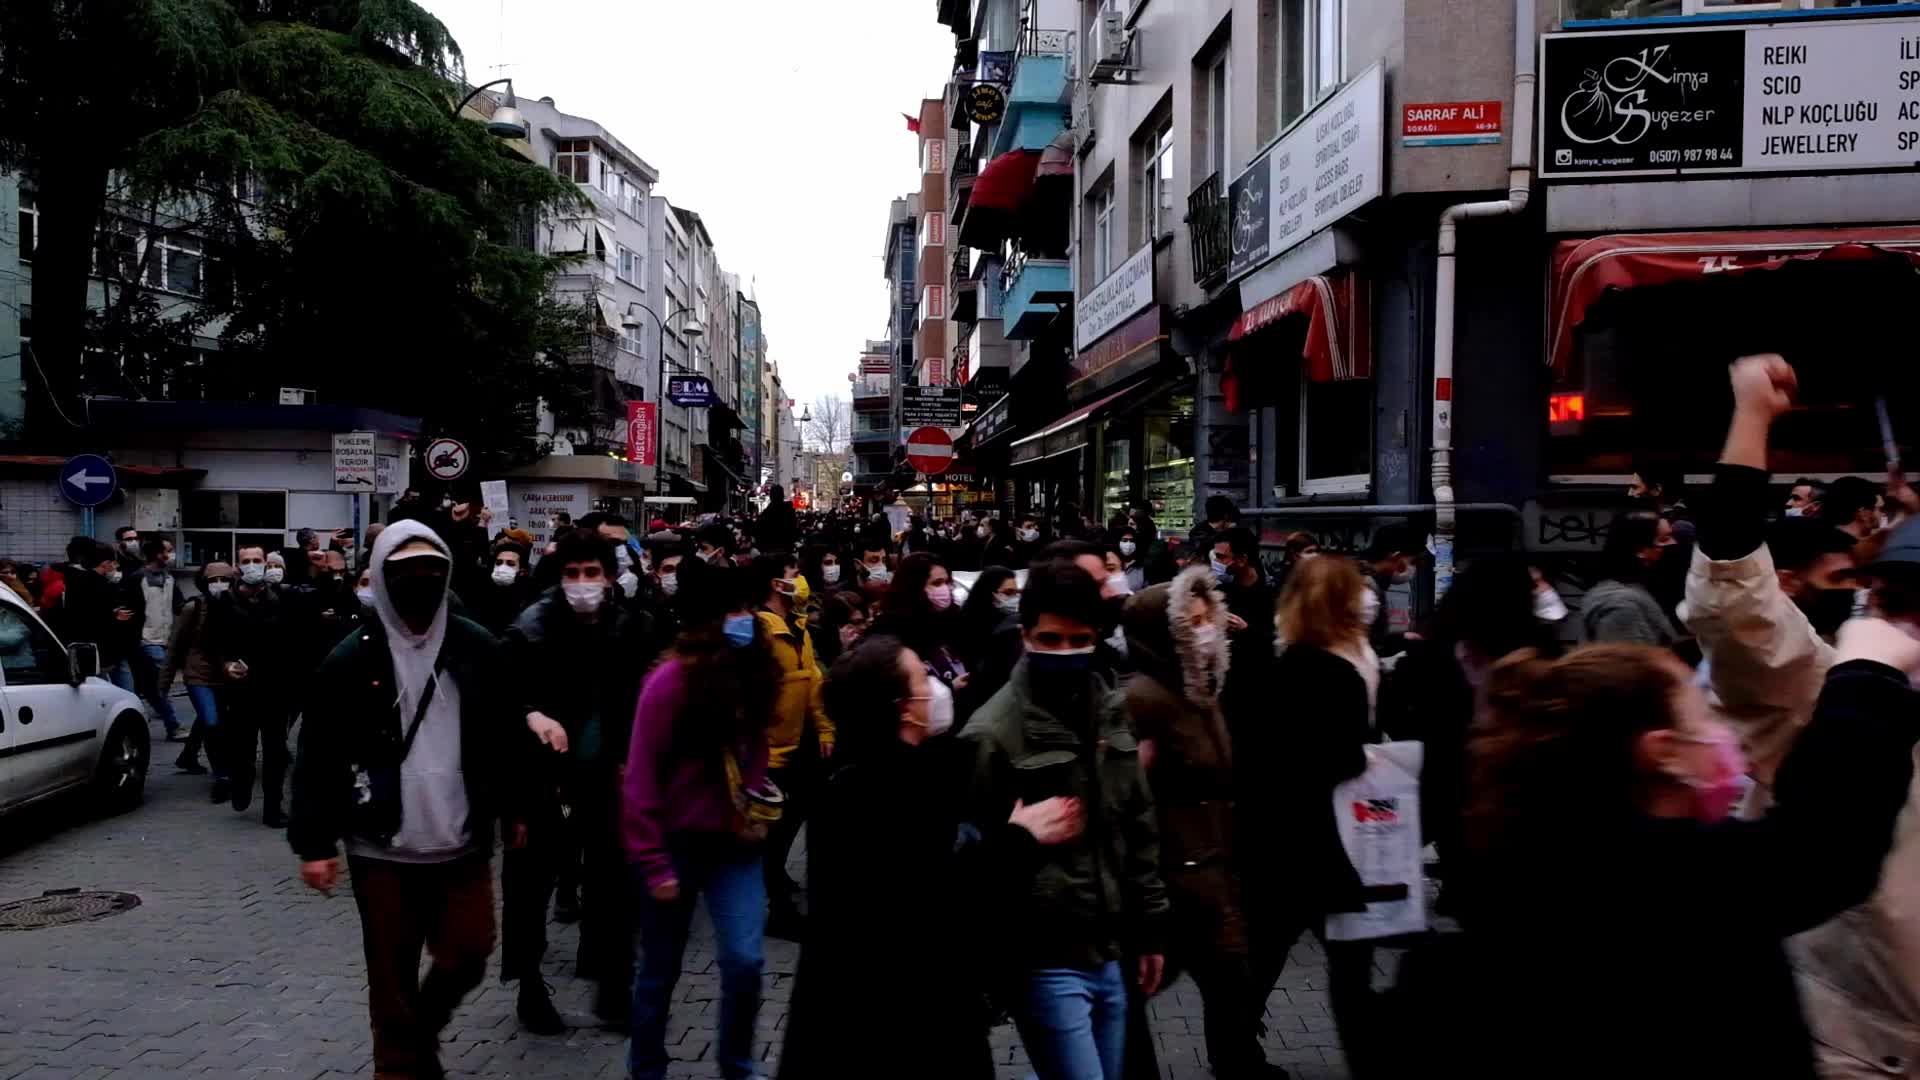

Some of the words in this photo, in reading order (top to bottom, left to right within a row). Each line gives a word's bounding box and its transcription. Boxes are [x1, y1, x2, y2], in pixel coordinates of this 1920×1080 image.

[1764, 45, 1807, 65] REIKI
[1603, 44, 1709, 93] Kimya
[1763, 75, 1801, 95] SCIO
[1407, 108, 1458, 122] SARRAF
[1462, 104, 1485, 120] ALİ
[1613, 89, 1716, 144] Sugezer
[1762, 105, 1794, 125] NLP
[1800, 101, 1878, 127] KOÇLUĞU
[1761, 133, 1858, 155] JEWELLERY
[1649, 149, 1681, 163] 0(507)
[1683, 148, 1702, 161] 987
[1705, 148, 1718, 161] 98
[1720, 147, 1734, 159] 44
[633, 406, 648, 464] Justenglish
[944, 474, 975, 482] HOTEL
